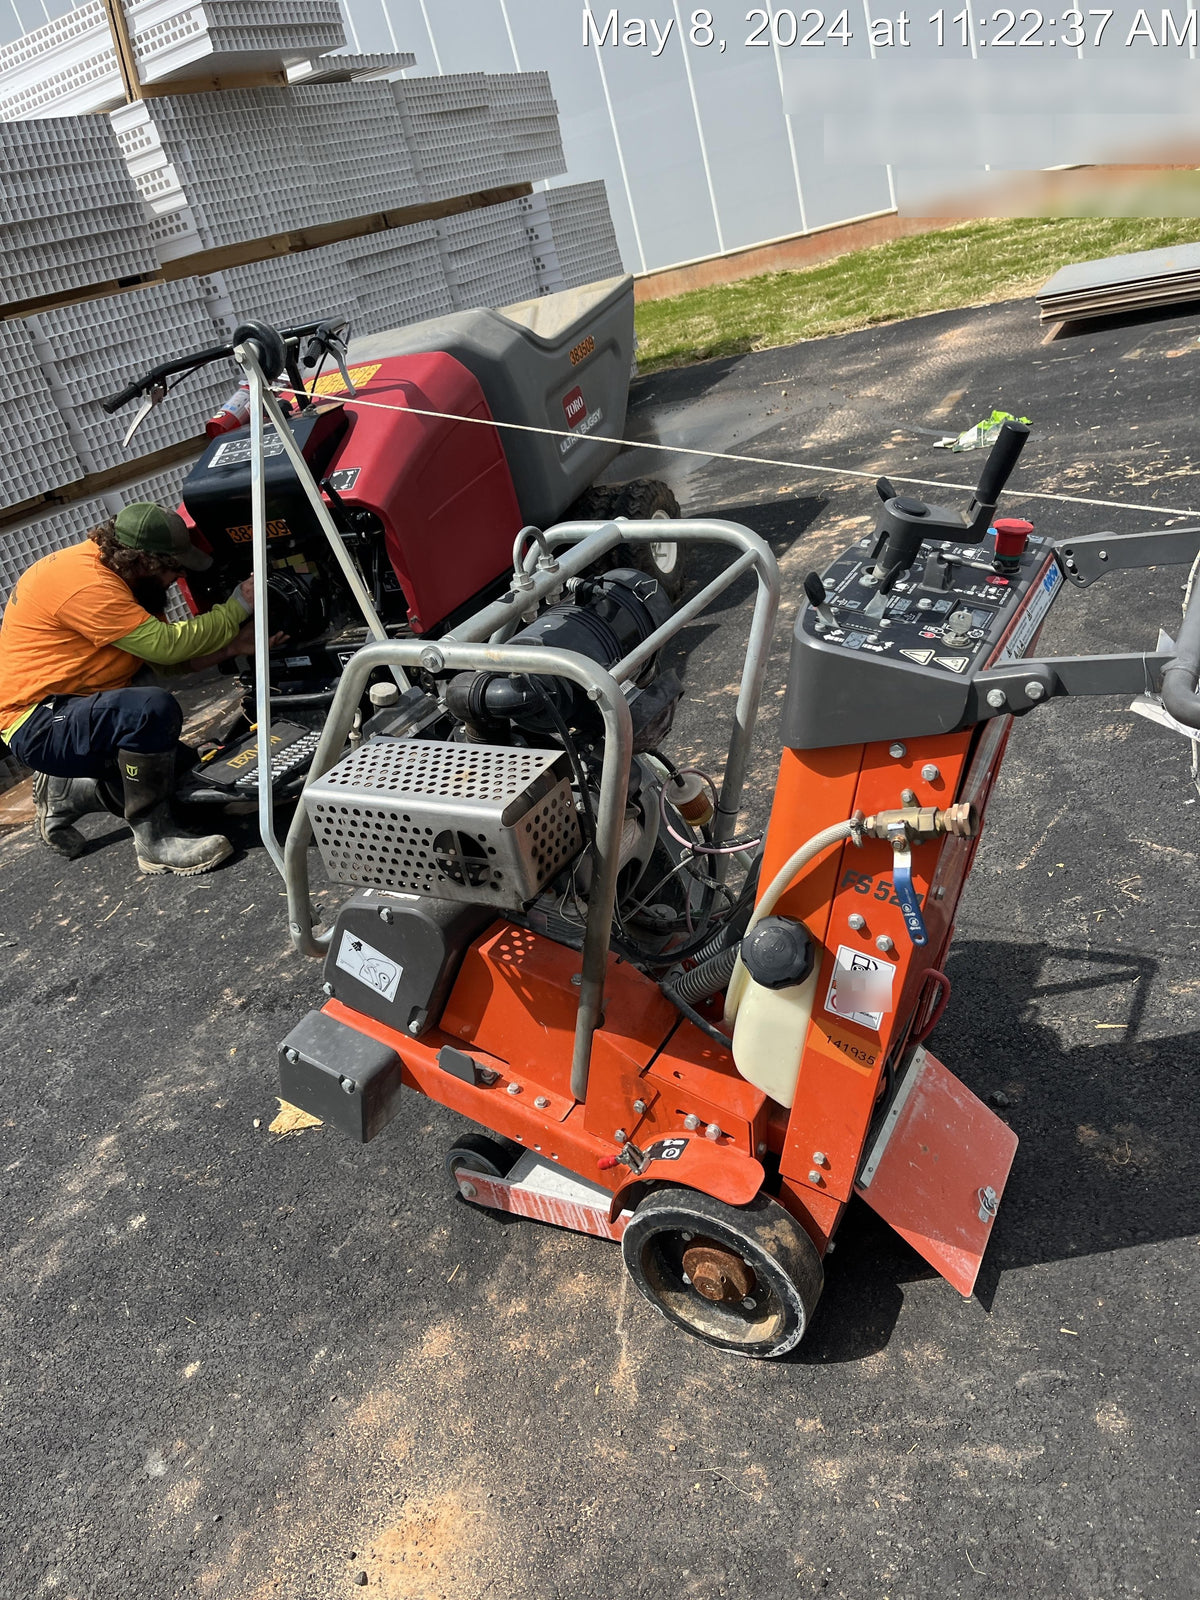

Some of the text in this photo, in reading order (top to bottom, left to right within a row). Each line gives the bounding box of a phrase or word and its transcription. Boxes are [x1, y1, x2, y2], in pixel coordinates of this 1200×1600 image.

[569, 335, 595, 366] 383509
[565, 396, 584, 419] TORO
[580, 407, 603, 436] BUGGY
[228, 521, 289, 542] 3809
[840, 869, 873, 895] FS
[826, 1034, 875, 1066] 141935
